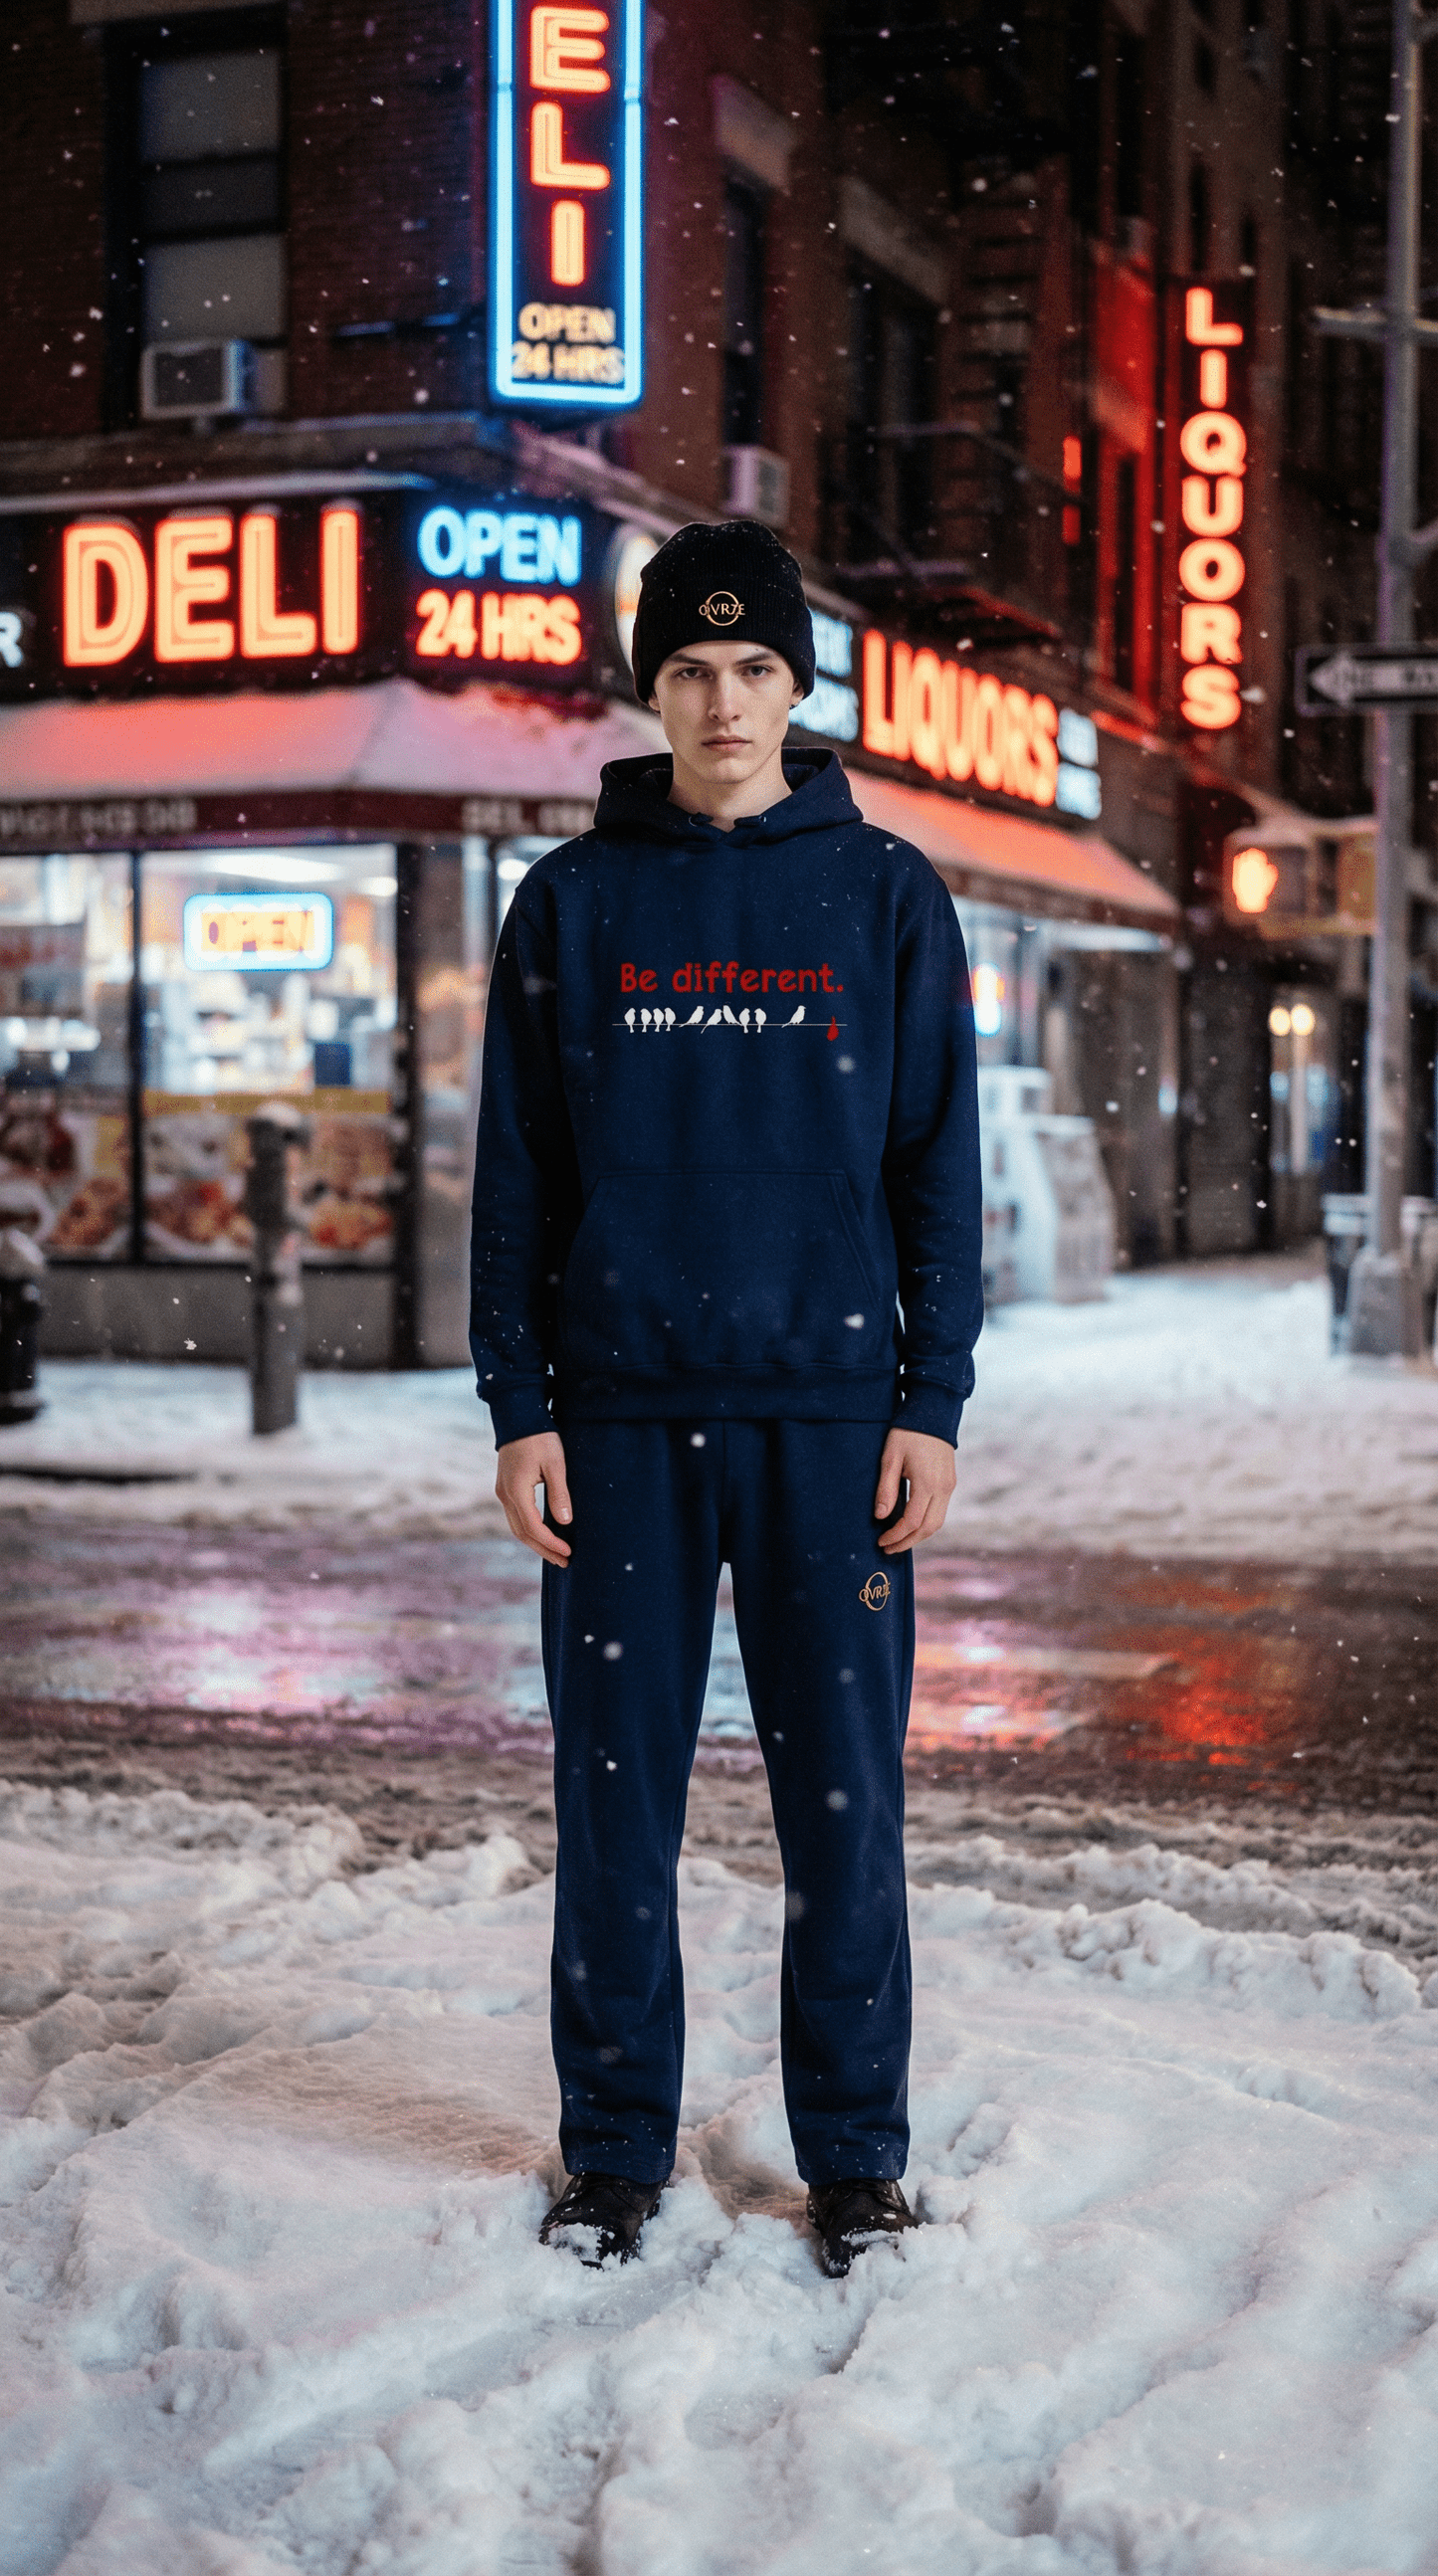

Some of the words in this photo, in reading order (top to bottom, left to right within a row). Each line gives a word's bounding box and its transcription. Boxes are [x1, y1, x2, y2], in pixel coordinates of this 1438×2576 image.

[518, 301, 616, 343] OPEN
[513, 340, 550, 379] 24
[553, 343, 626, 385] HRS
[417, 505, 582, 587] OPEN
[1178, 286, 1248, 730] LIQUORS
[63, 508, 360, 668] DELI
[416, 588, 479, 659] 24
[481, 591, 582, 666] HRS
[863, 629, 1059, 807] LIQUORS
[620, 961, 659, 993] Be
[672, 960, 844, 993] different.
